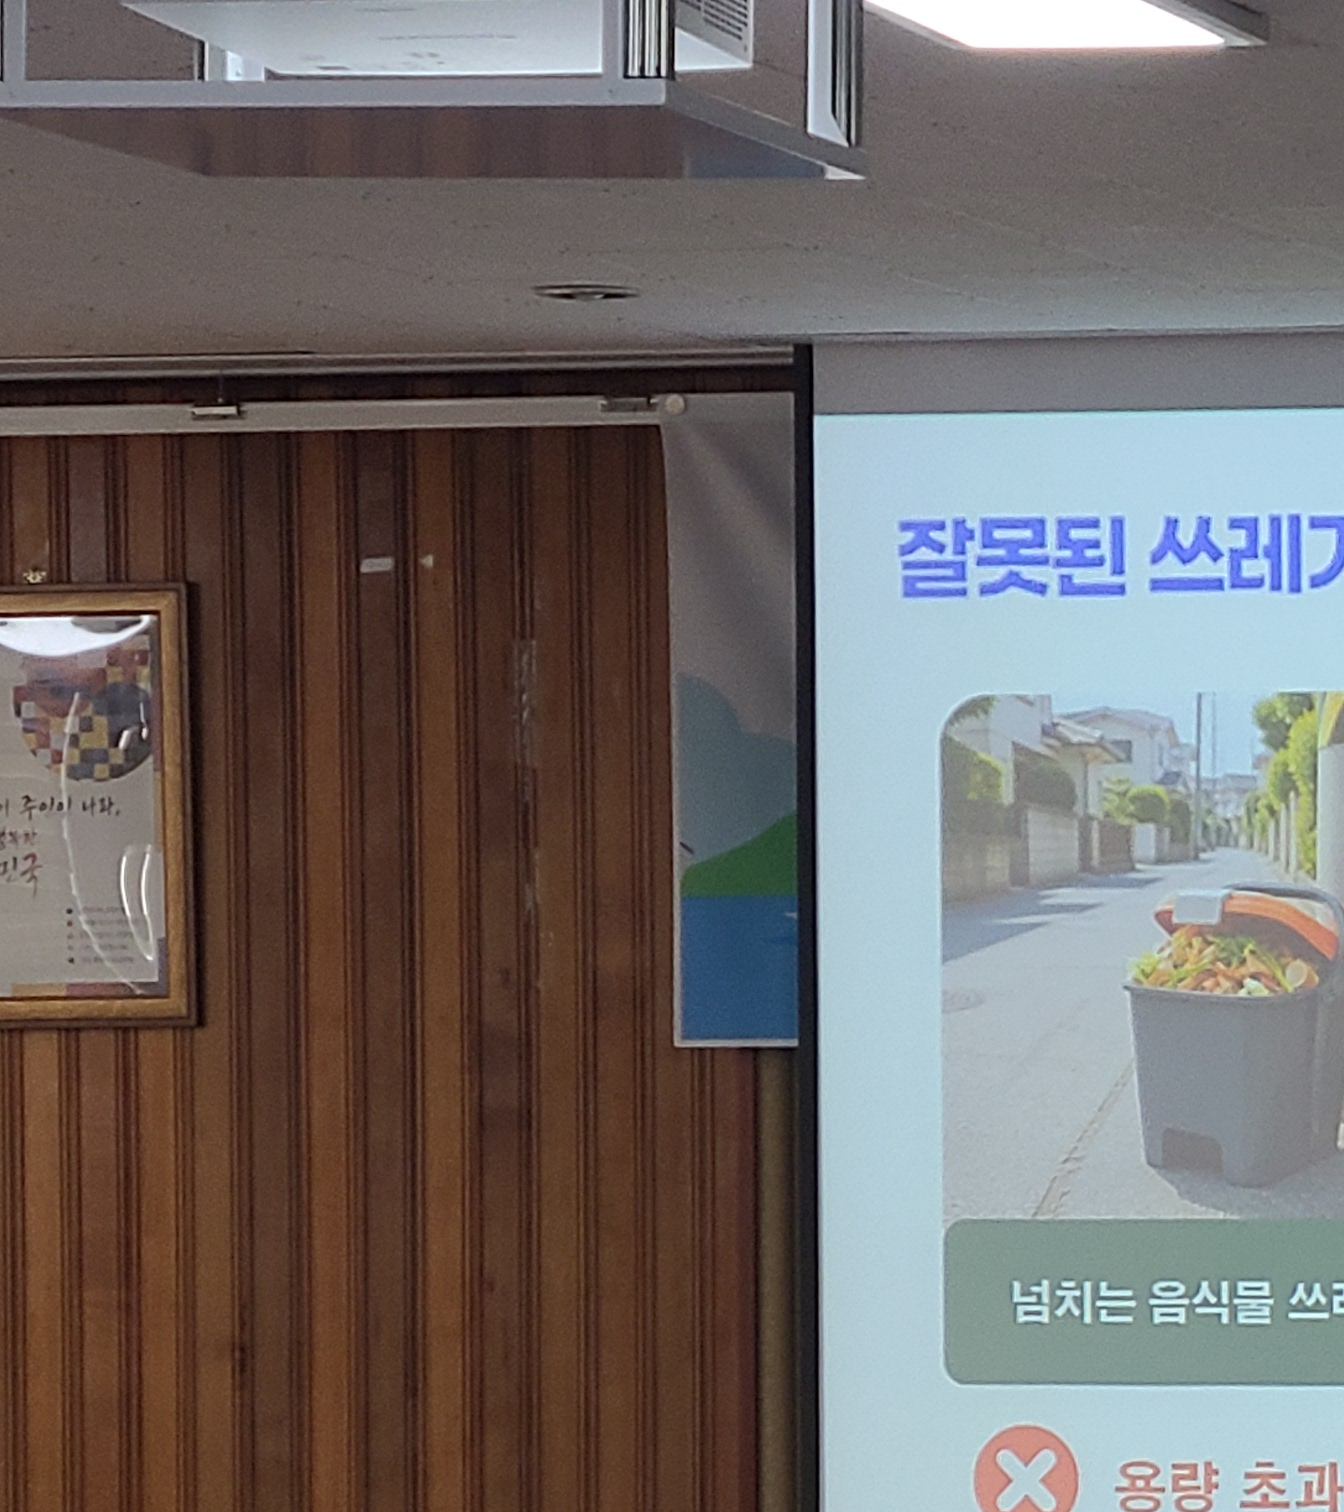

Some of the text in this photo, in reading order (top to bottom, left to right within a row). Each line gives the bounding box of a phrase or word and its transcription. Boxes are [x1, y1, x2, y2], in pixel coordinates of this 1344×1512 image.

[898, 516, 1127, 599] 잘못된
[1012, 1279, 1137, 1324] 넘치는
[1148, 1280, 1275, 1325] 음식물
